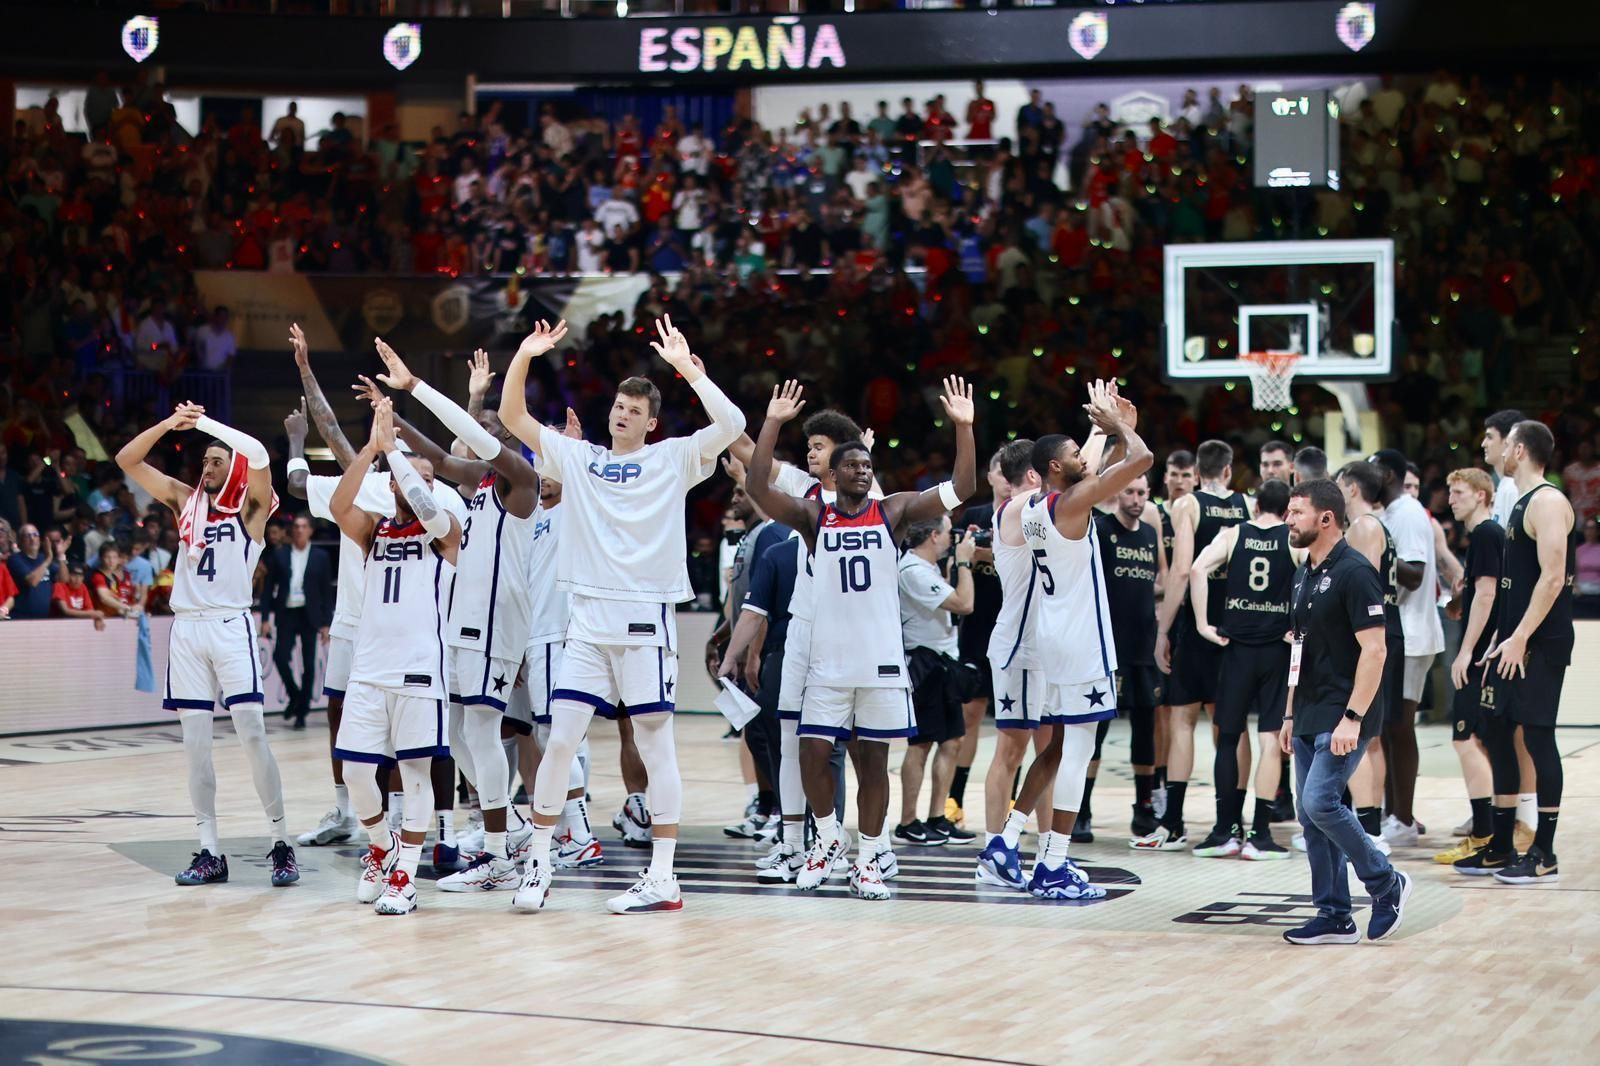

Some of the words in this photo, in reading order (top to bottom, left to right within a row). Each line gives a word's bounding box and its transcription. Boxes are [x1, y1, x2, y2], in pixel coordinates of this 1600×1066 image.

[639, 16, 846, 72] ESPAÑA
[203, 523, 235, 544] SA
[373, 541, 423, 561] USA
[823, 530, 882, 552] USA
[196, 547, 217, 582] 4
[1032, 548, 1055, 595] 5
[1116, 546, 1154, 563] ESPAÑA
[382, 566, 402, 603] 11
[838, 555, 872, 594] 10
[1248, 556, 1271, 592] 8
[1239, 598, 1285, 613] CaixaBank
